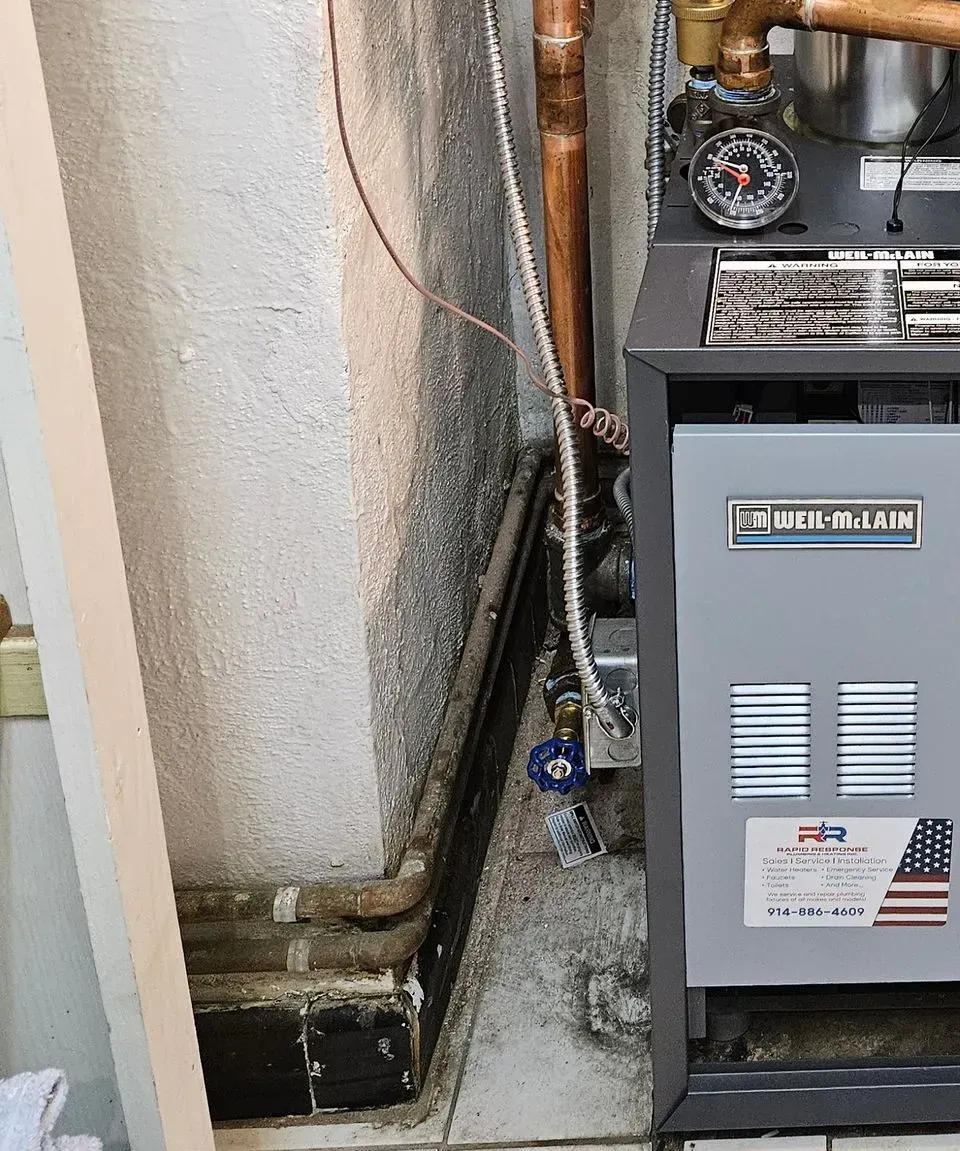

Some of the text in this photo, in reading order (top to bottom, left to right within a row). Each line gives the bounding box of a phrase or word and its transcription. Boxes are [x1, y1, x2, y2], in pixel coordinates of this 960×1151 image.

[828, 250, 934, 260] WEIL-McLAIN
[773, 510, 914, 530] WEIL-McLAIN
[767, 907, 864, 916] 914-886-4609
